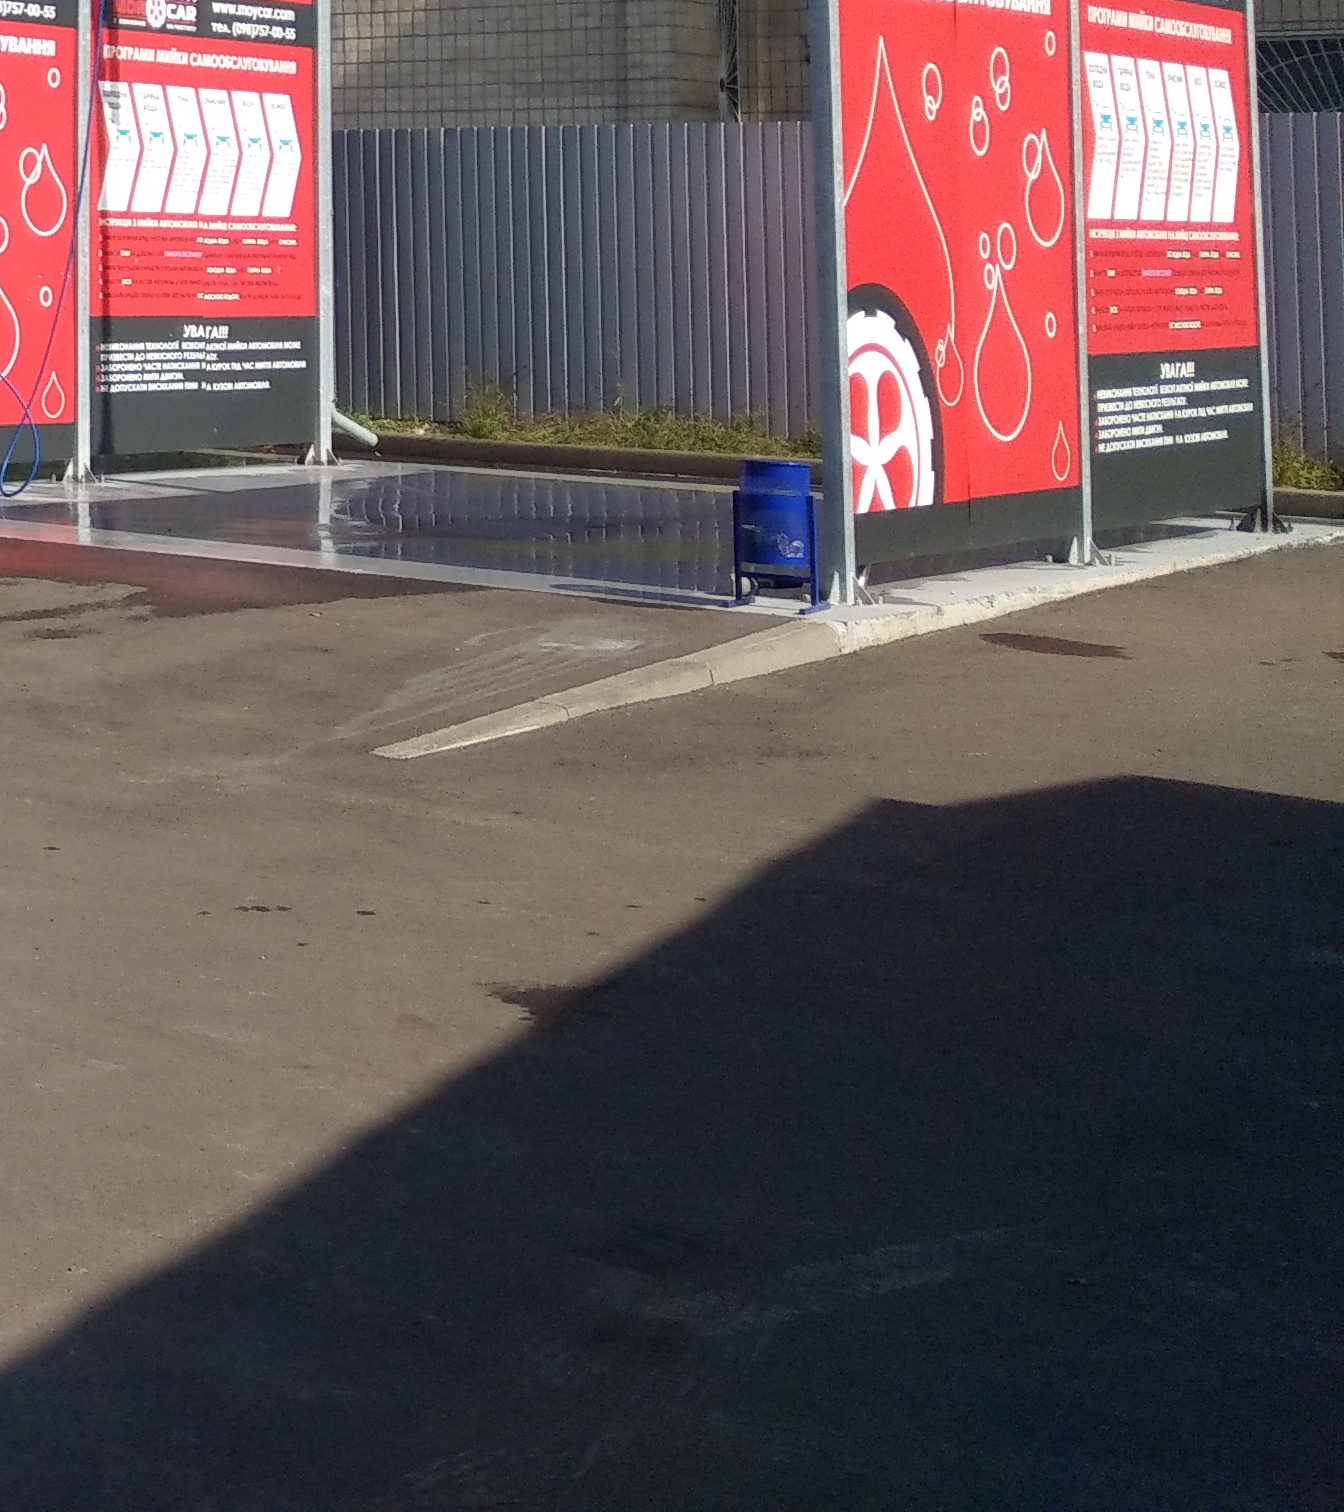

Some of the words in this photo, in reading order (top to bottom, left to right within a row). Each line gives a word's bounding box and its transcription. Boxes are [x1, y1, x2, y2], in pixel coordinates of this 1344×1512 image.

[167, 4, 197, 22] CAR
[212, 1, 296, 21] www.moycar.com
[1087, 5, 1127, 28] ПРОГРАМИ
[211, 22, 231, 34] тел.
[232, 21, 297, 41] (098)757-00-55
[103, 44, 155, 63] ПРОГРАМИ
[156, 47, 189, 66] МИЙКИ
[189, 52, 297, 75] САМООБСЛУГОВУВАННЯ
[183, 324, 229, 339] УВАГА!!!
[1160, 361, 1196, 379] УВАГА!!!
